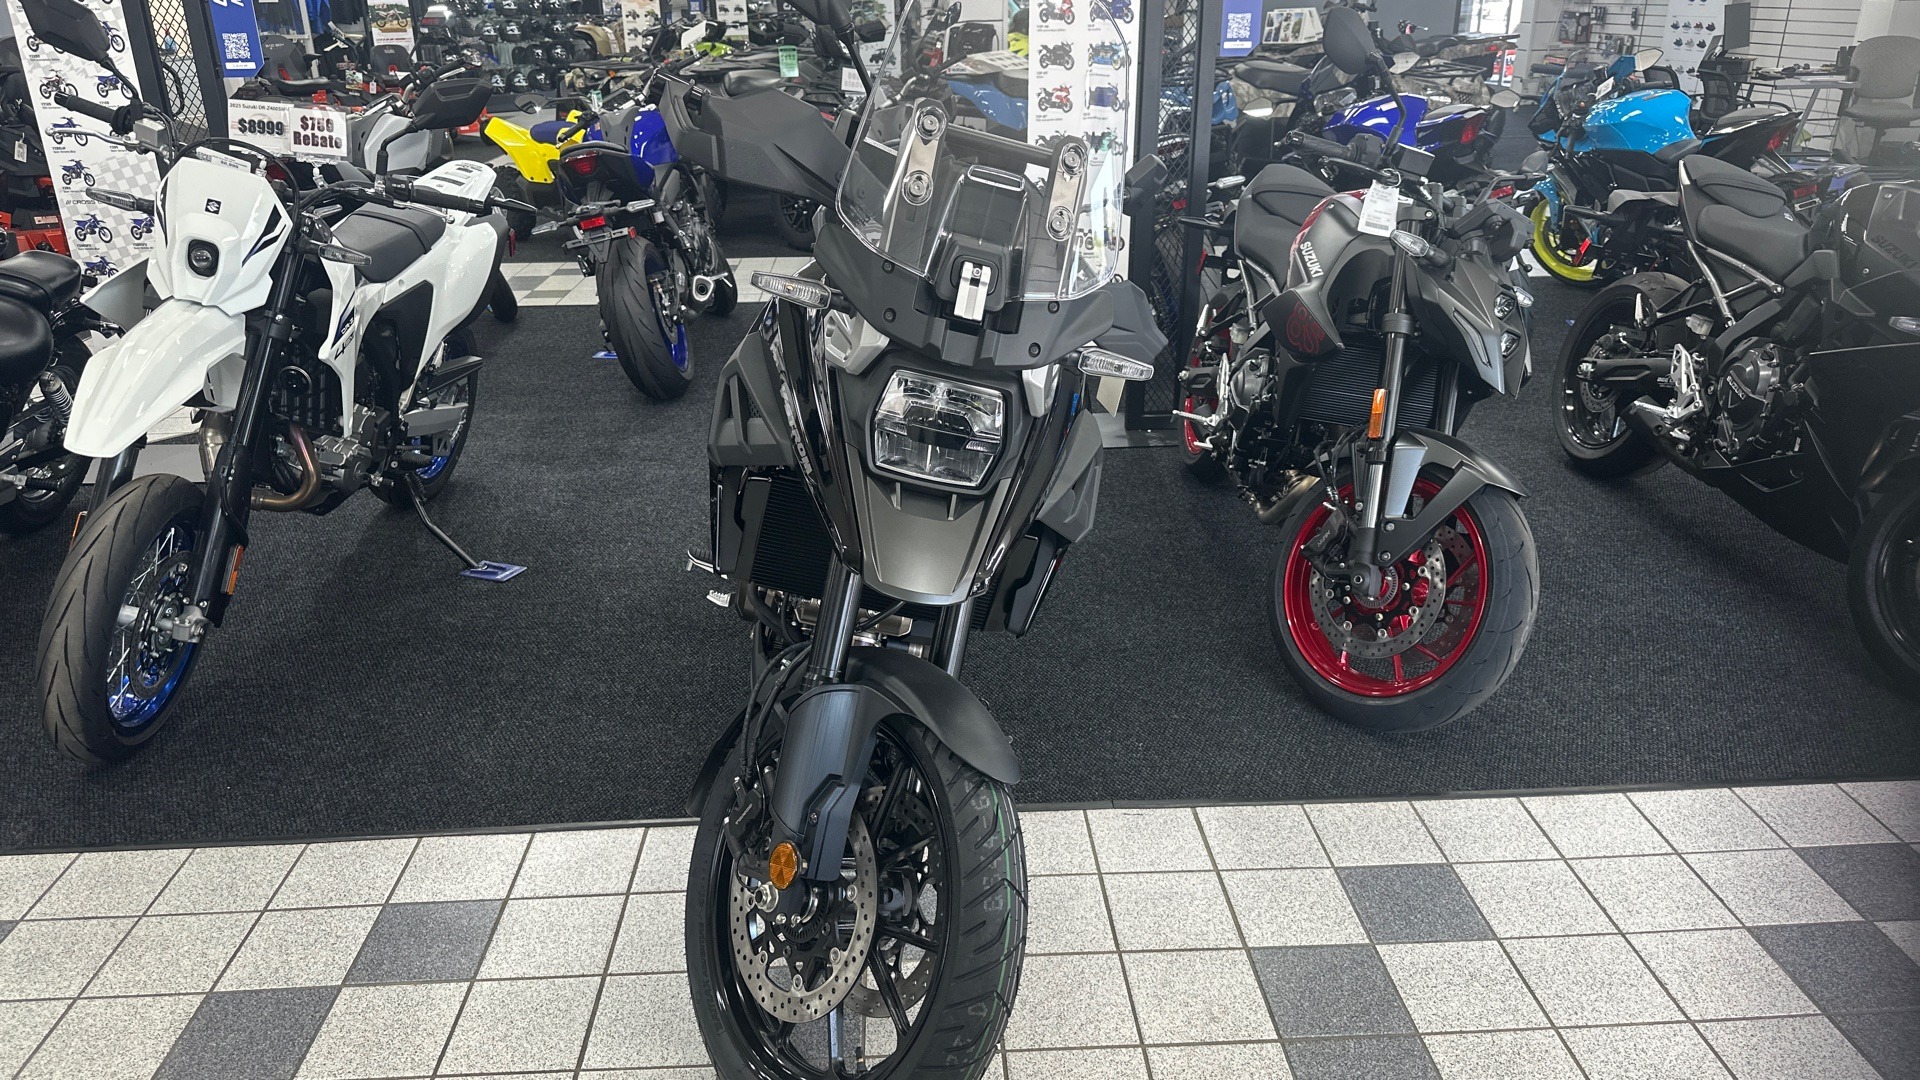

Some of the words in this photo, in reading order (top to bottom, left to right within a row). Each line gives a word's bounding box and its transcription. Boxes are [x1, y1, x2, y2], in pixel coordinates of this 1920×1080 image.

[238, 117, 285, 136] $8999
[300, 115, 334, 133] $750
[292, 131, 343, 149] Rebate
[1300, 241, 1324, 278] SUZUKI
[1726, 375, 1747, 400] SUZUKI
